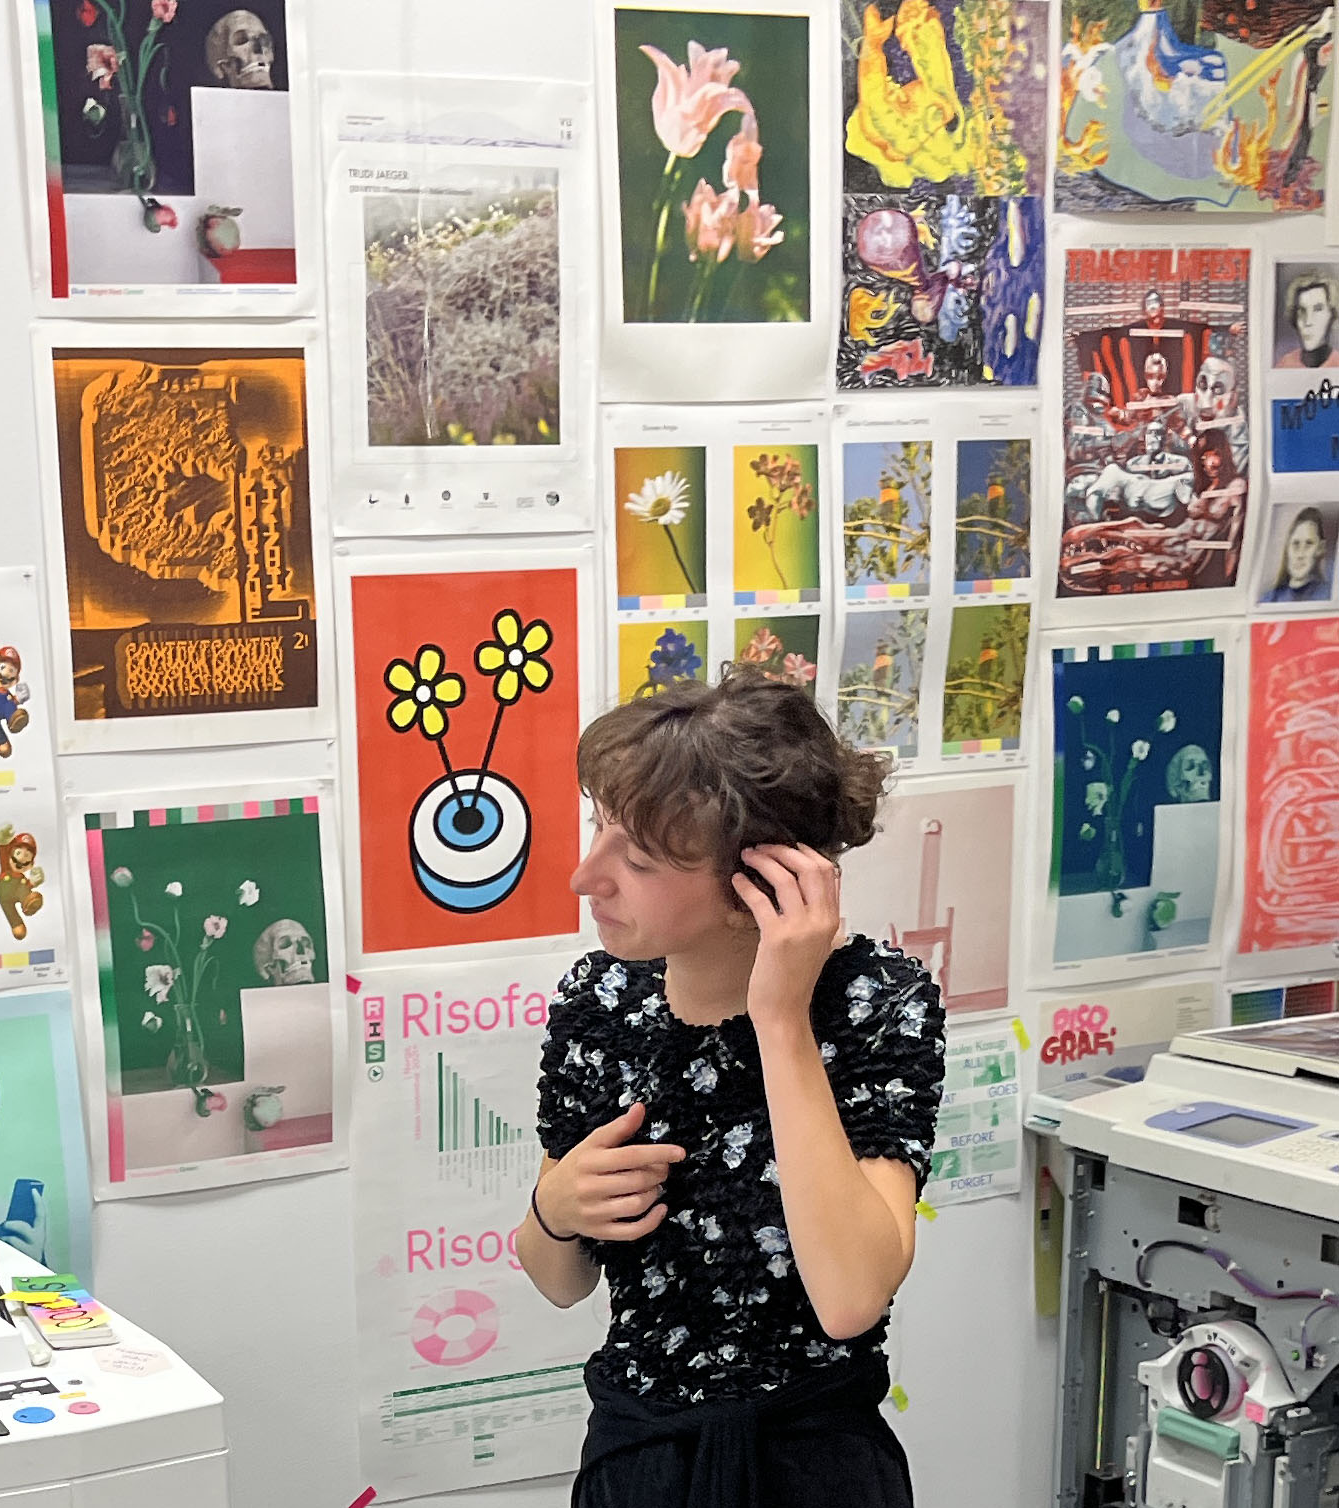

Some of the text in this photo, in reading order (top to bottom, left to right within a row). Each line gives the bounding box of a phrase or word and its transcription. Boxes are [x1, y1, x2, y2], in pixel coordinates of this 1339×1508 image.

[348, 168, 408, 180] TRUDI JAEGER
[402, 983, 557, 1039] Risofa
[963, 1058, 981, 1069] ALL
[988, 1082, 1019, 1097] GOES
[950, 1131, 995, 1147] BEFORE
[950, 1173, 995, 1191] FORGET
